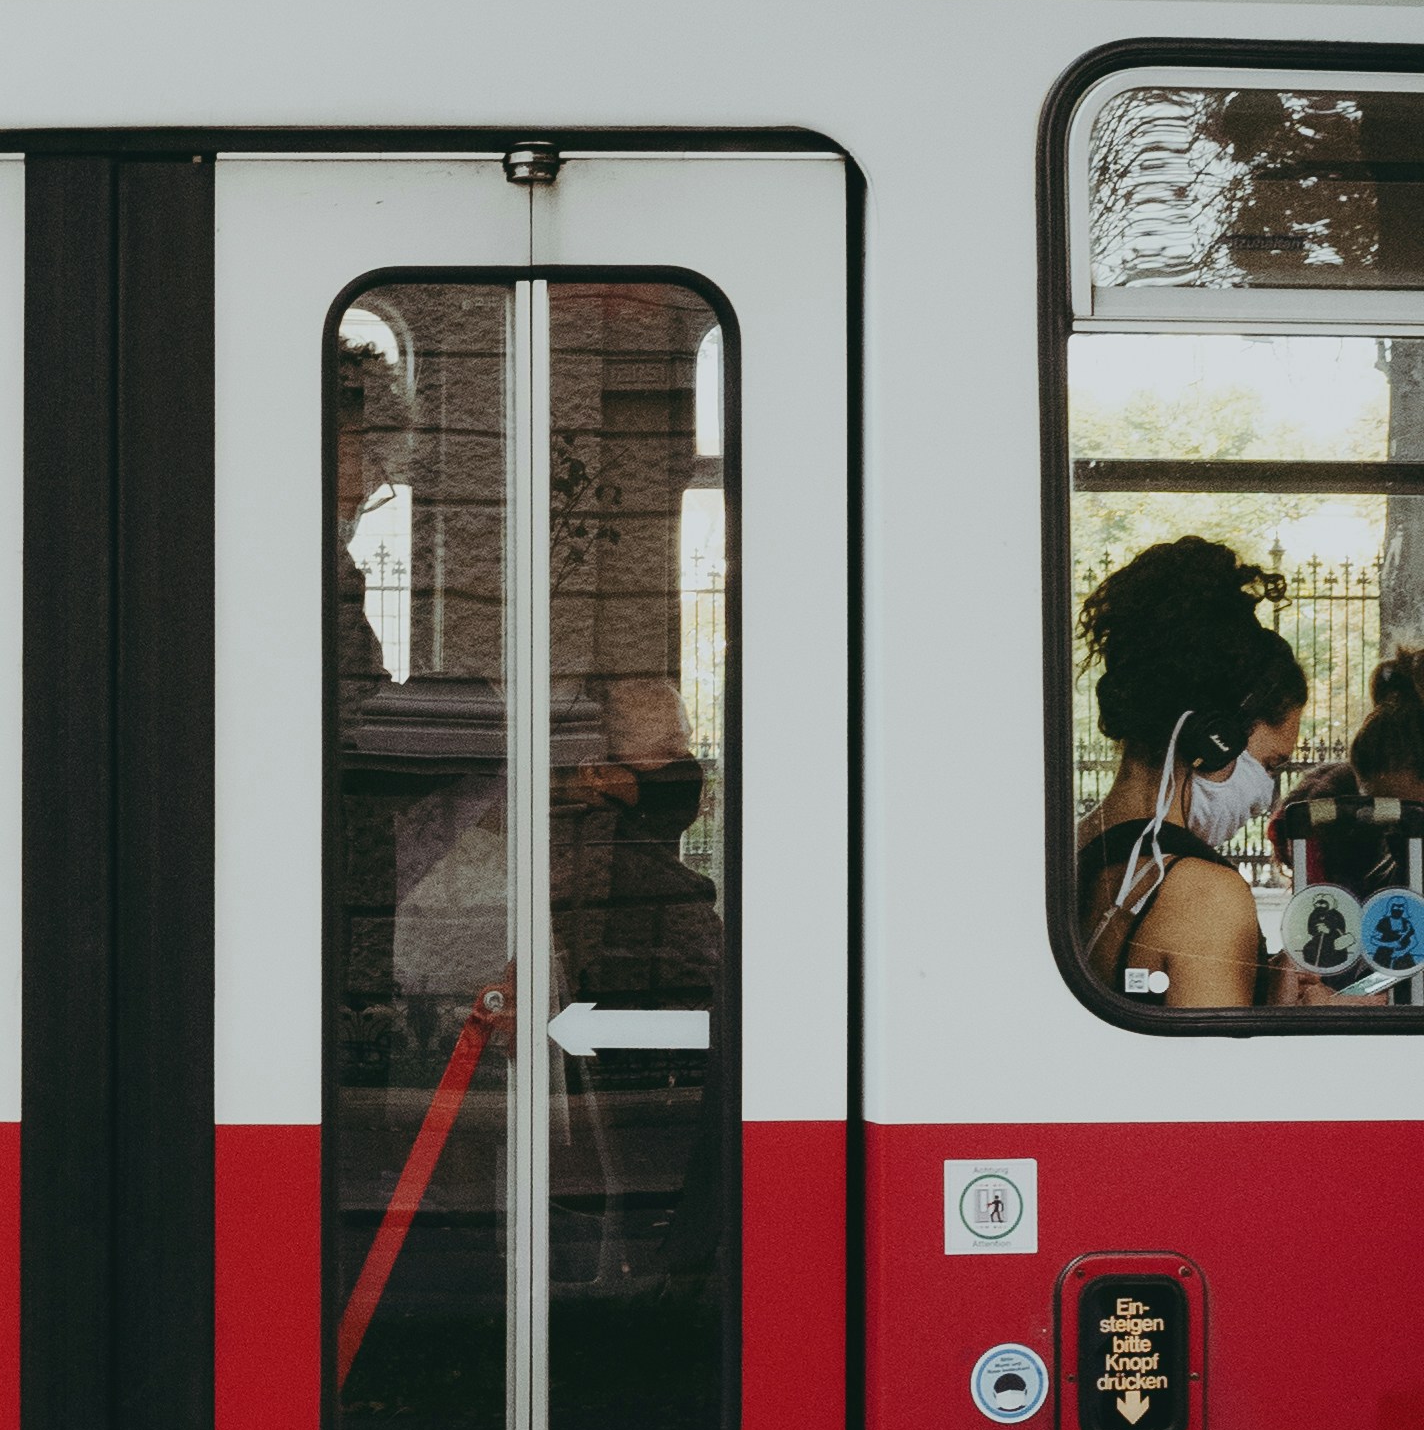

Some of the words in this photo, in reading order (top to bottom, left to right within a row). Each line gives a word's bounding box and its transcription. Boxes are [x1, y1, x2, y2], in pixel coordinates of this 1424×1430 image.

[972, 1240, 1012, 1248] Attention
[1117, 1298, 1150, 1315] Ein-
[1099, 1316, 1165, 1335] steigen
[1113, 1335, 1152, 1353] bitte
[1105, 1353, 1160, 1374] Knopf
[1097, 1373, 1168, 1390] drücken
